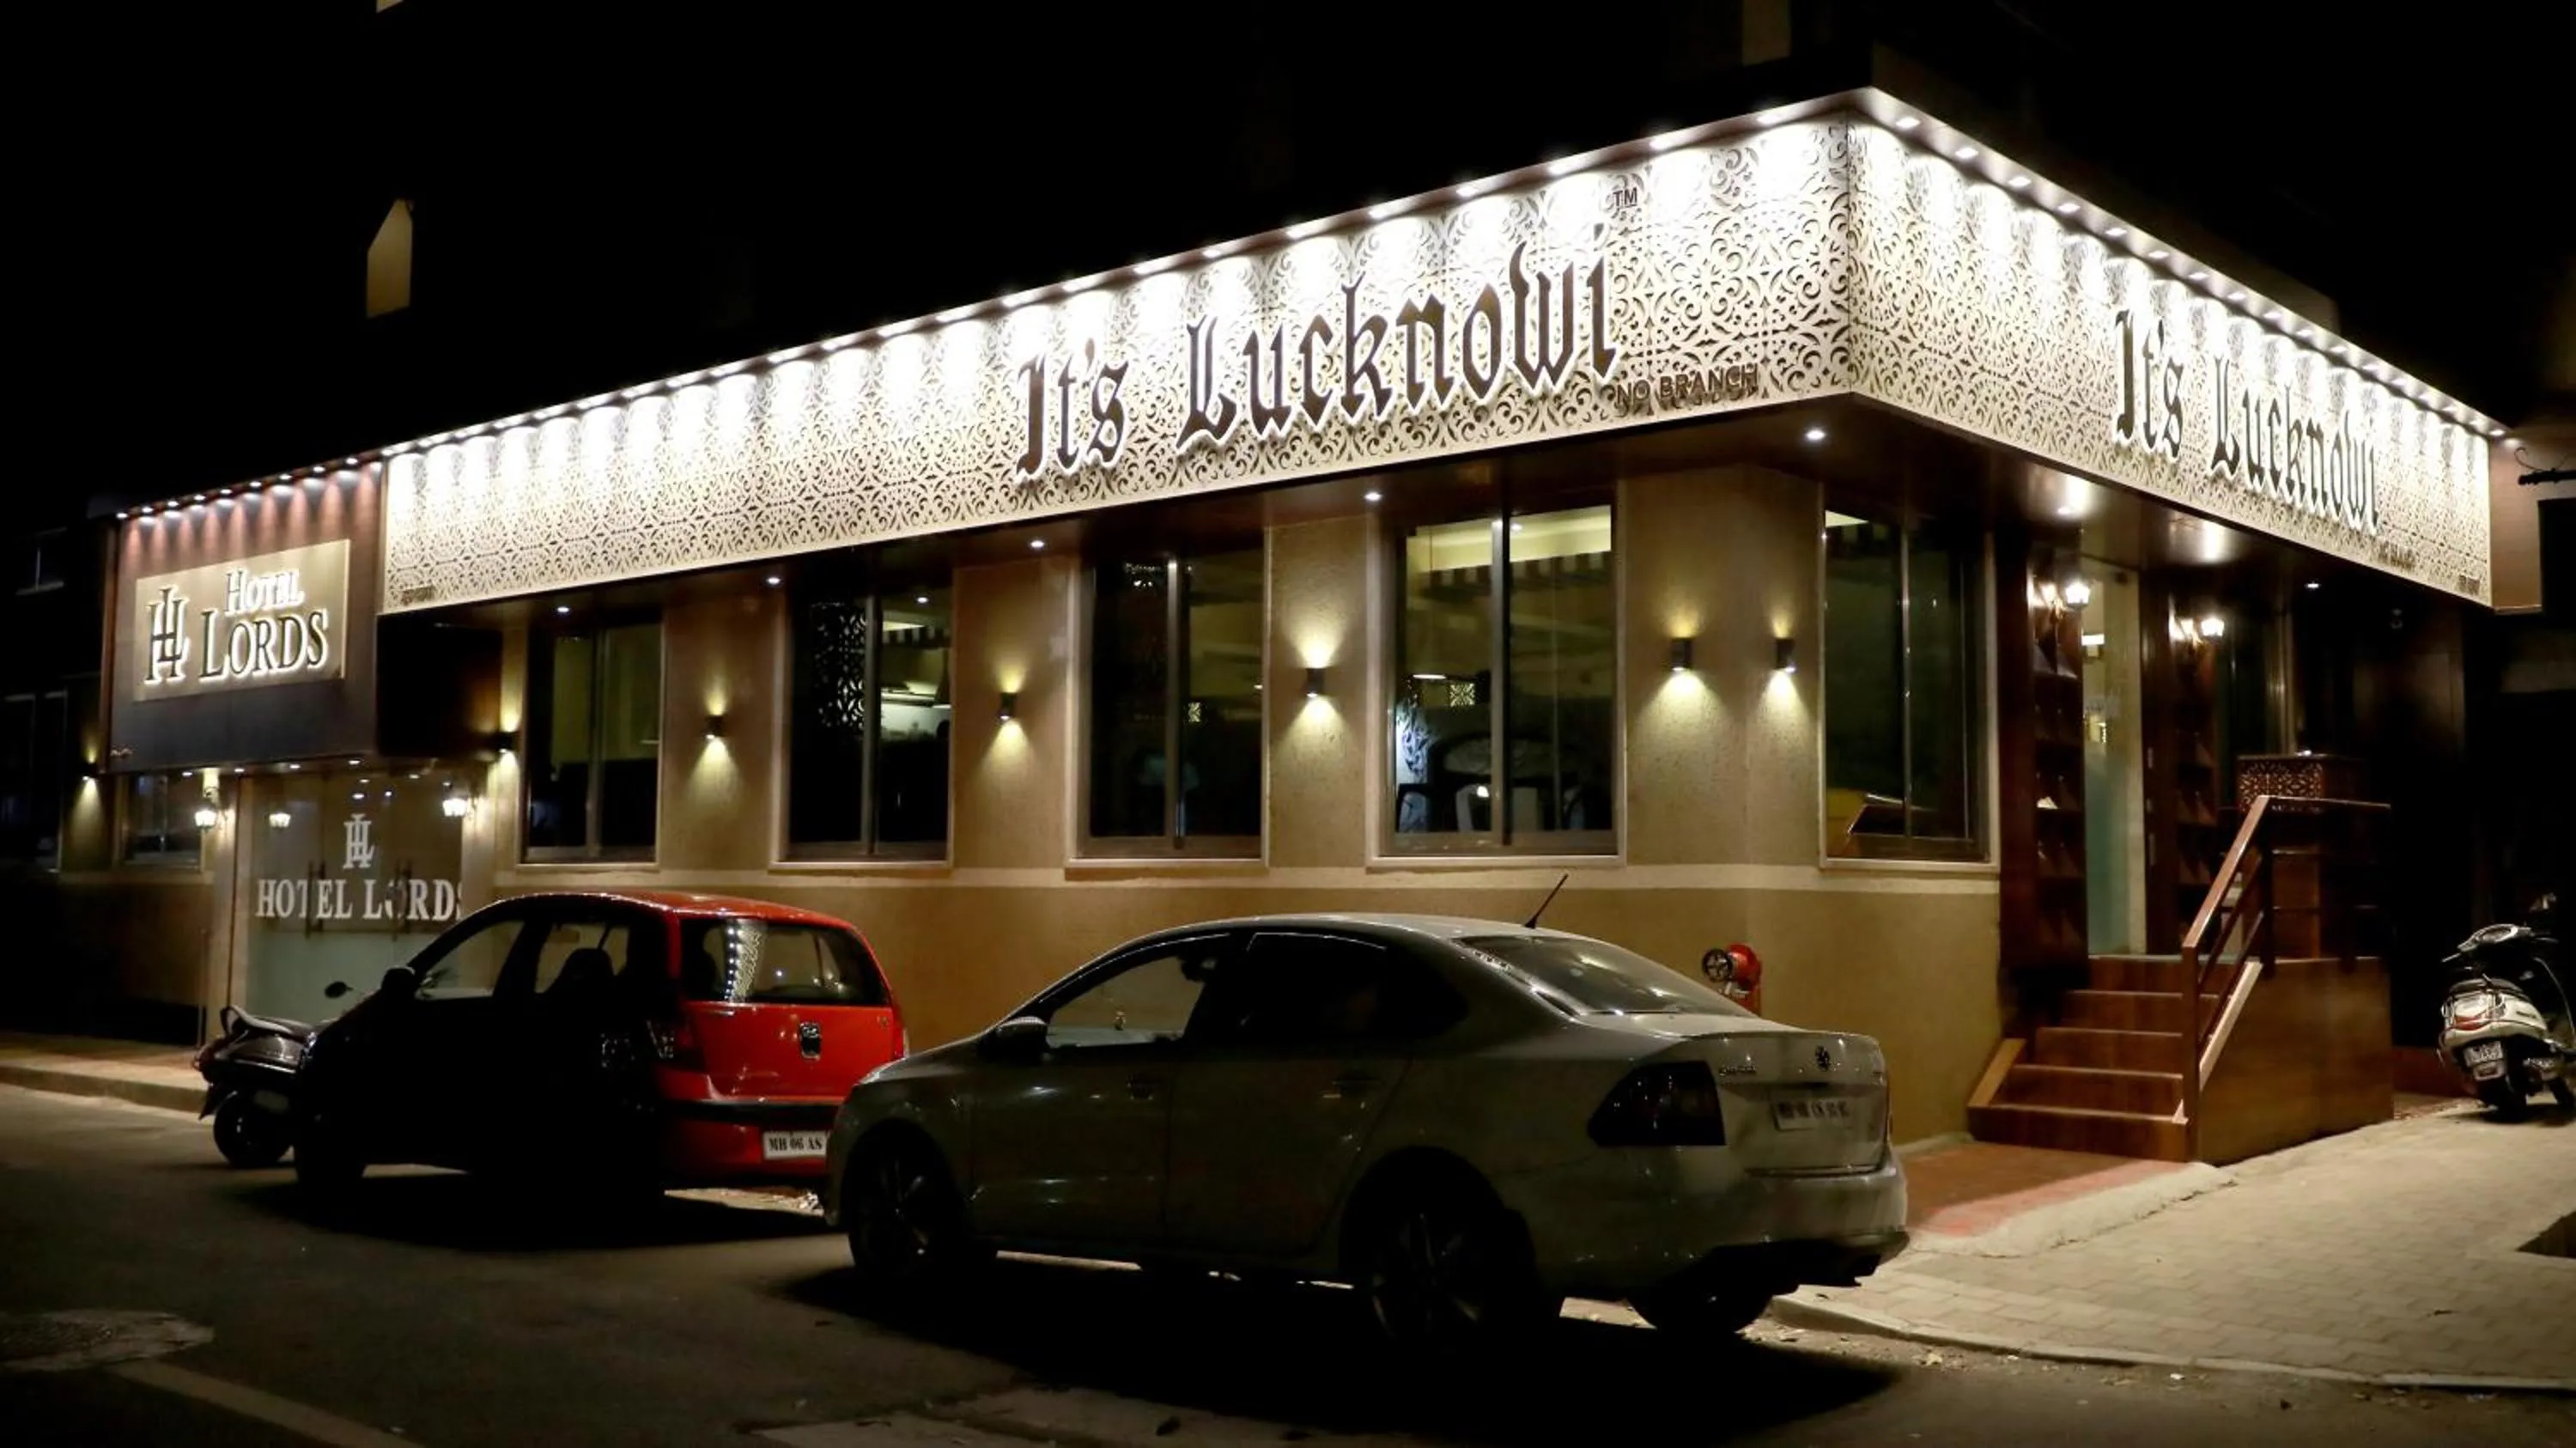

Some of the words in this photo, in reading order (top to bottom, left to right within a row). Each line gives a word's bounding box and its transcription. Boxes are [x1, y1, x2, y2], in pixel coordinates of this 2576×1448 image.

[1613, 188, 1637, 207] TM
[1016, 338, 1129, 475] It's
[1176, 222, 1617, 448] Lucknowi
[1617, 380, 1650, 404] NO
[1660, 362, 1759, 398] BRANCH
[2115, 308, 2184, 459] It's
[199, 609, 328, 680] LORDS
